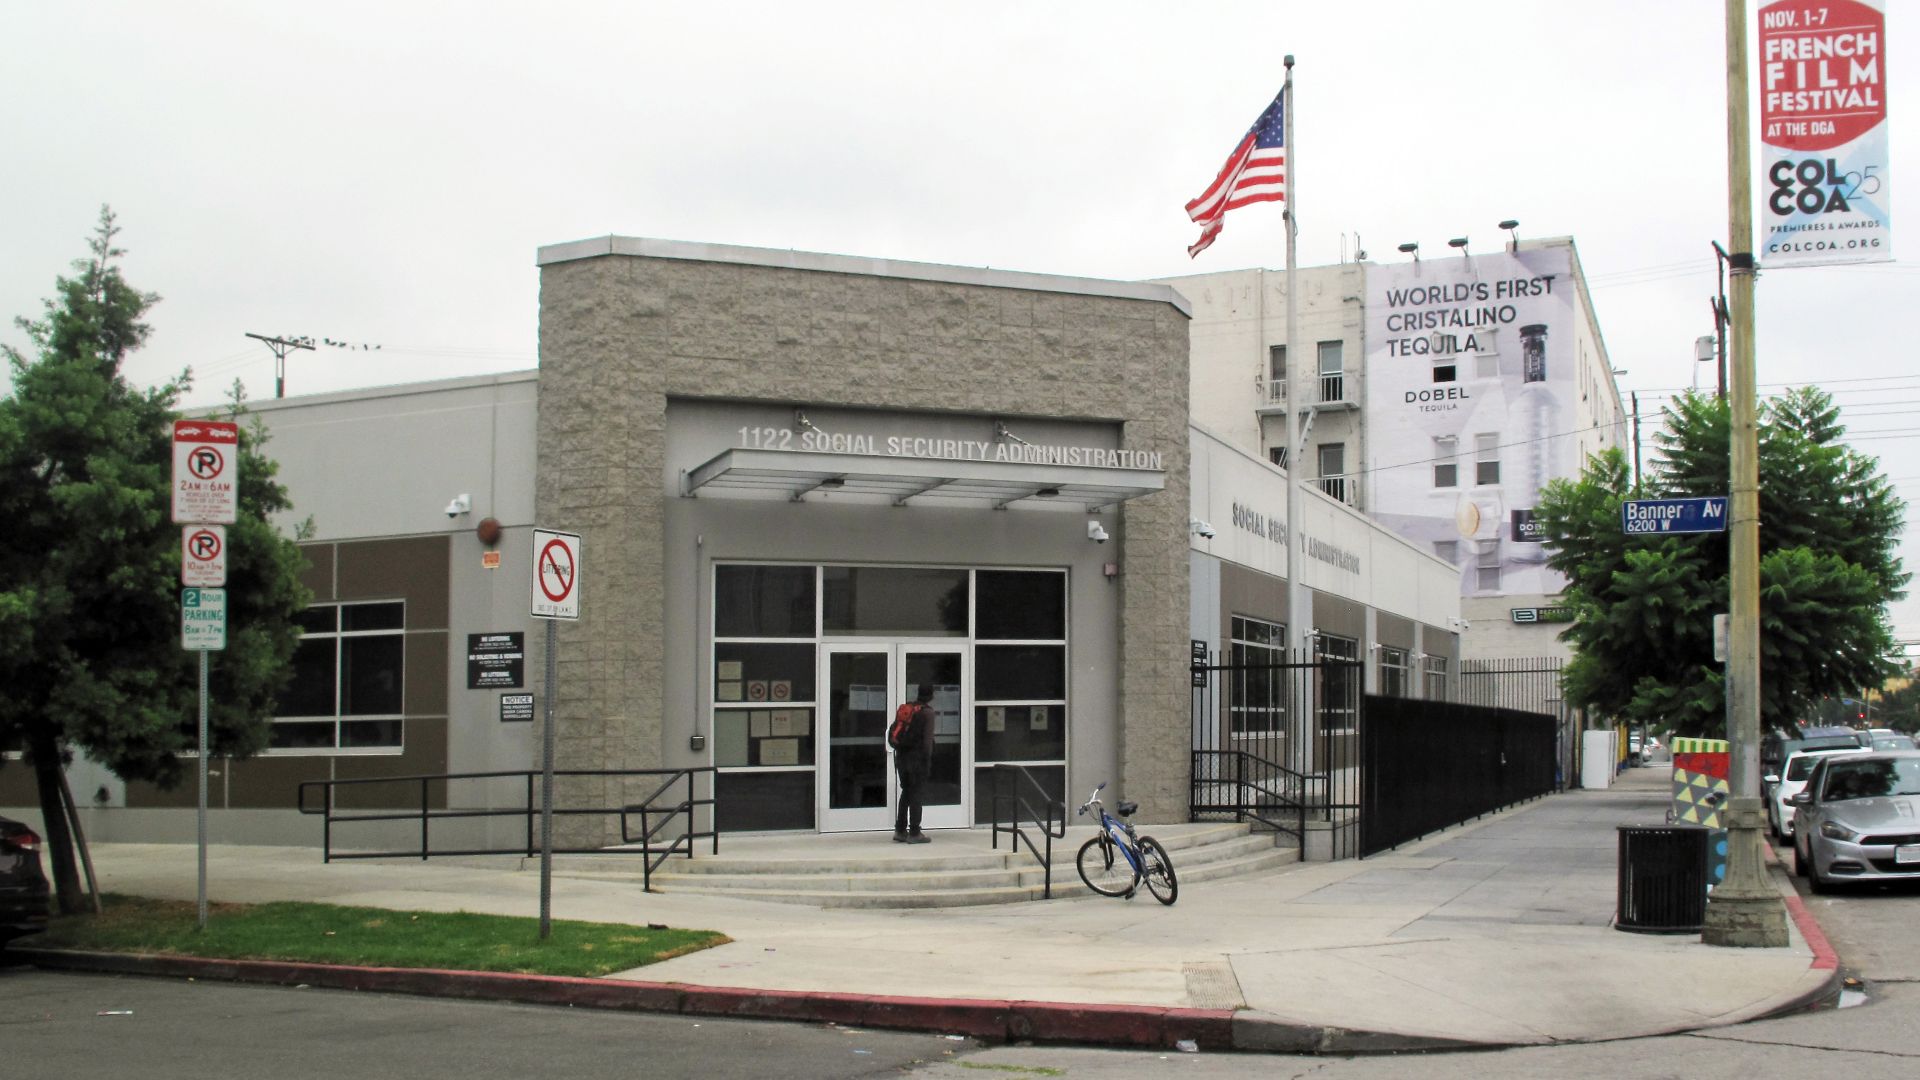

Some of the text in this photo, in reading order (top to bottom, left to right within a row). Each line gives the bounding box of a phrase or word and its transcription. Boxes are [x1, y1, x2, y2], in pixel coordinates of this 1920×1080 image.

[1764, 8, 1828, 28] NOV. 1-7
[1765, 32, 1877, 62] FRENCH
[1767, 56, 1879, 90] FILM
[1767, 88, 1879, 113] FESTIVAL
[1767, 120, 1836, 137] AT THE DGA
[1769, 158, 1881, 201] COL 25
[1769, 186, 1851, 216] COA
[1770, 223, 1825, 233] PREMIERES
[1838, 220, 1880, 230] AWARDS
[1769, 238, 1880, 253] COLCOA.ORG
[1386, 275, 1556, 308] WORLD'S FIRST
[1387, 304, 1517, 332] CRISTALINO
[1387, 333, 1485, 358] TEQUILA.
[1405, 387, 1470, 404] DOBEL
[1419, 403, 1459, 413] TEQUILA
[738, 426, 1163, 471] 1122 SOCIAL SECURITY ADMINISTRATION
[1232, 502, 1266, 538] SOCIAL
[1627, 500, 1722, 520] Banner Av
[1627, 519, 1671, 532] 6200 W
[186, 591, 197, 605] 2
[184, 609, 223, 621] PARKING
